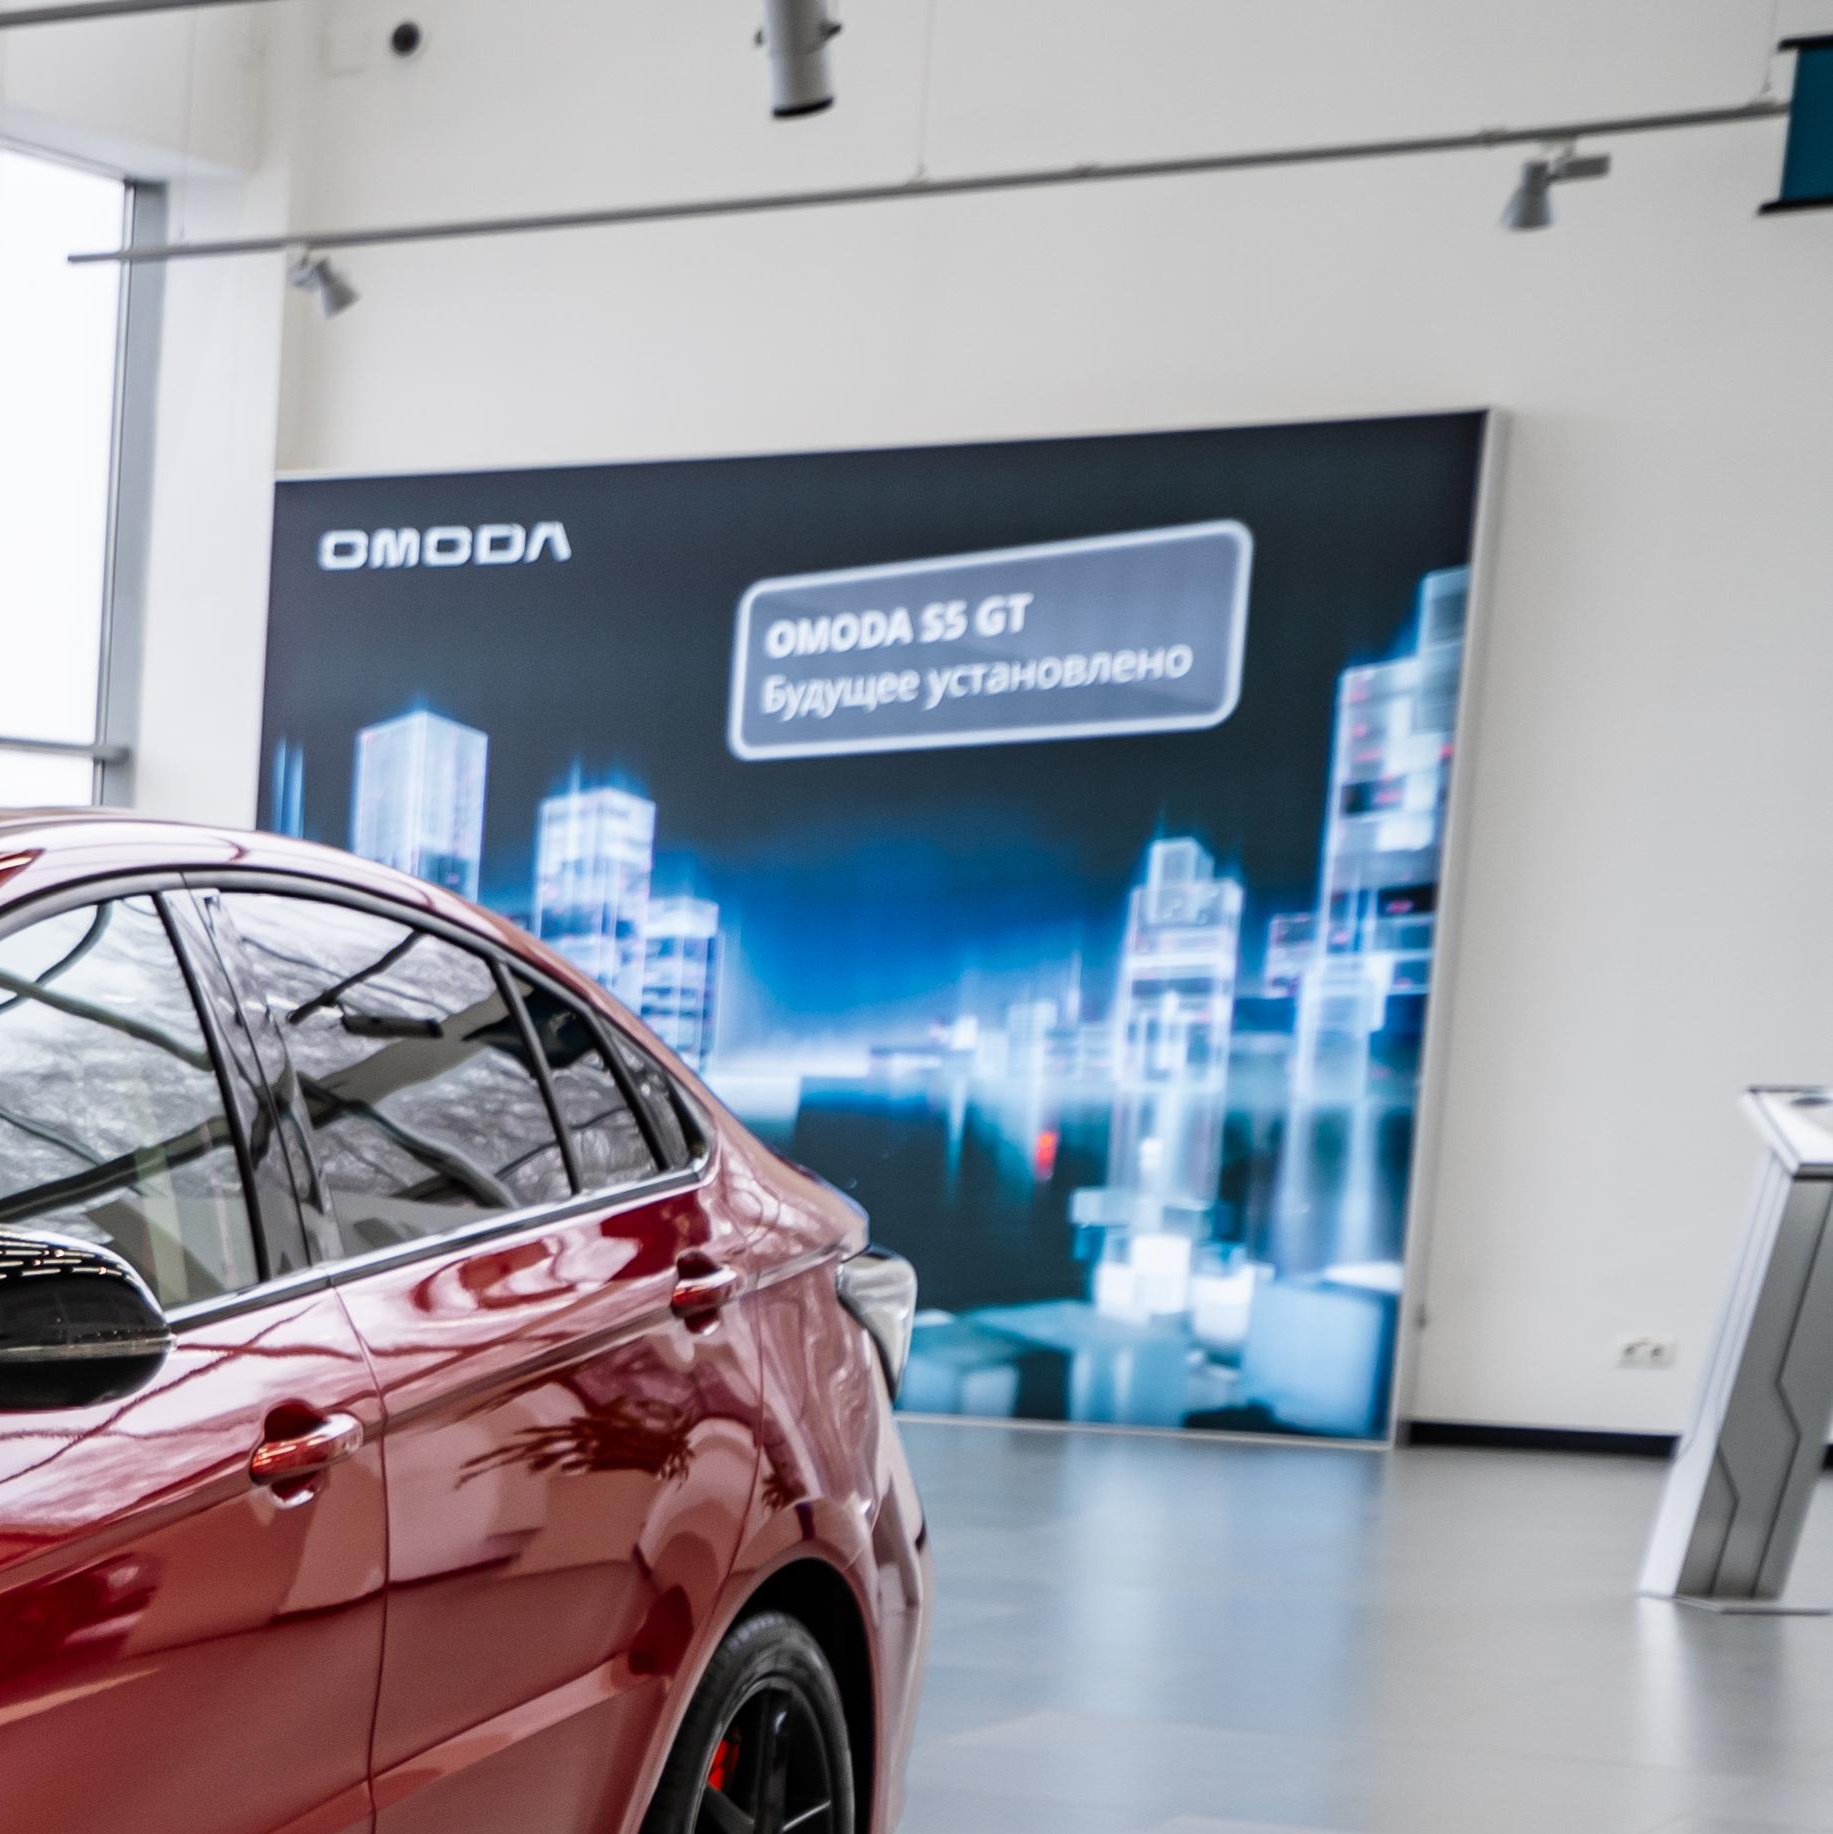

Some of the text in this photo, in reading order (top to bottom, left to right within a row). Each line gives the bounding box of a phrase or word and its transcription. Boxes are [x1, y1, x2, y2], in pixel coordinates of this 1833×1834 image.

[318, 521, 572, 571] OMODA
[765, 592, 1033, 659] OMODA S5 GT
[761, 643, 1194, 721] Будущее установлено
